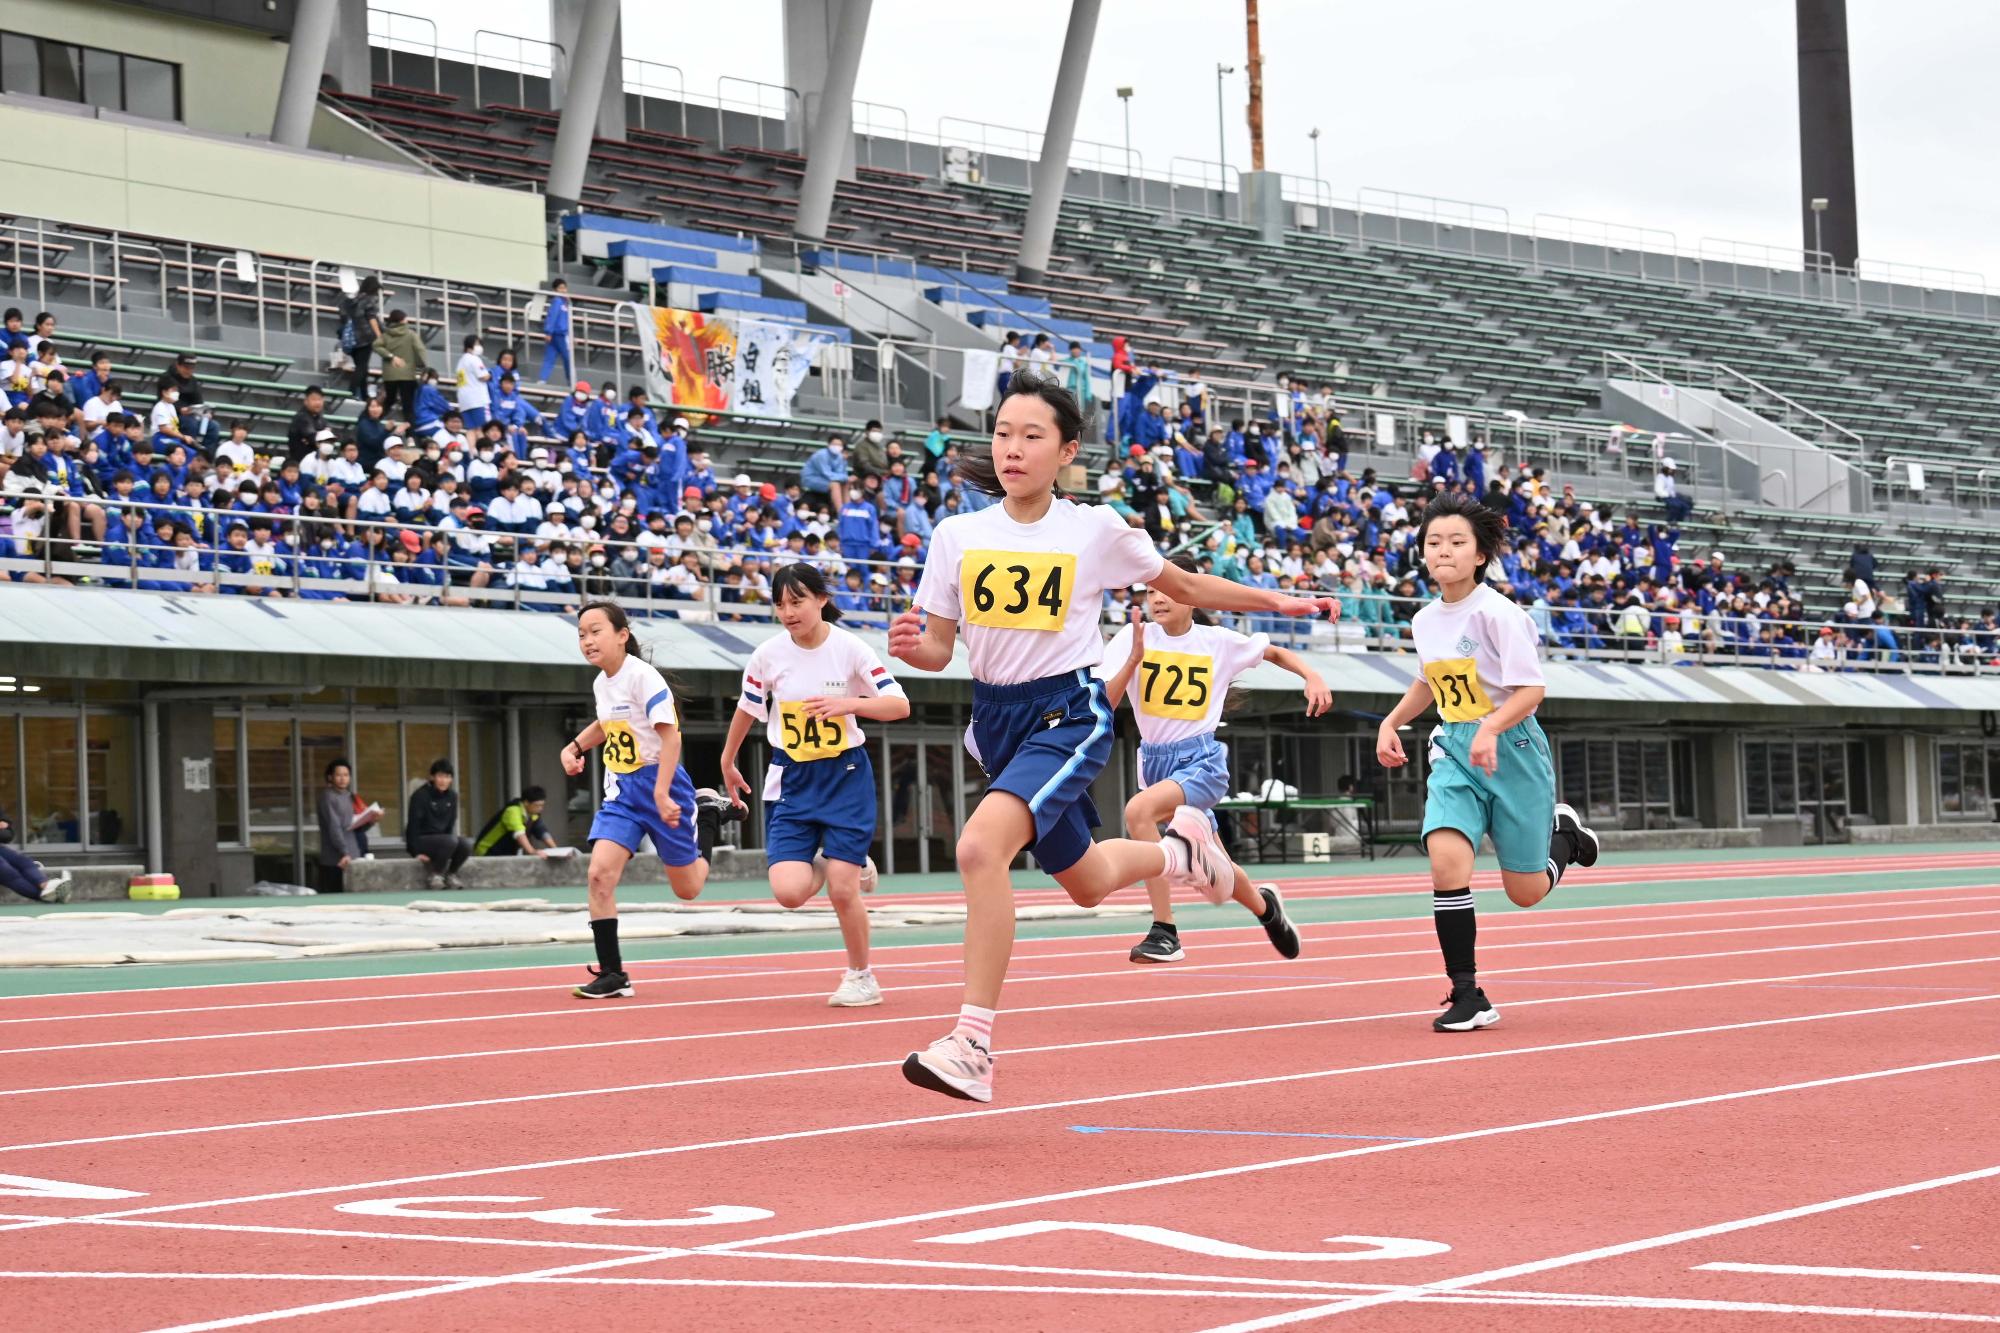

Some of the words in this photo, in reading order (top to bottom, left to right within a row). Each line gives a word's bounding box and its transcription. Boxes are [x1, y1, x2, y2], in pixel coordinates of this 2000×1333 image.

[974, 563, 1063, 617] 634
[1142, 661, 1209, 708] 725
[782, 713, 842, 750] 545
[1312, 837, 1321, 858] 6
[333, 1194, 776, 1227] 3
[912, 1219, 1453, 1262] 2
